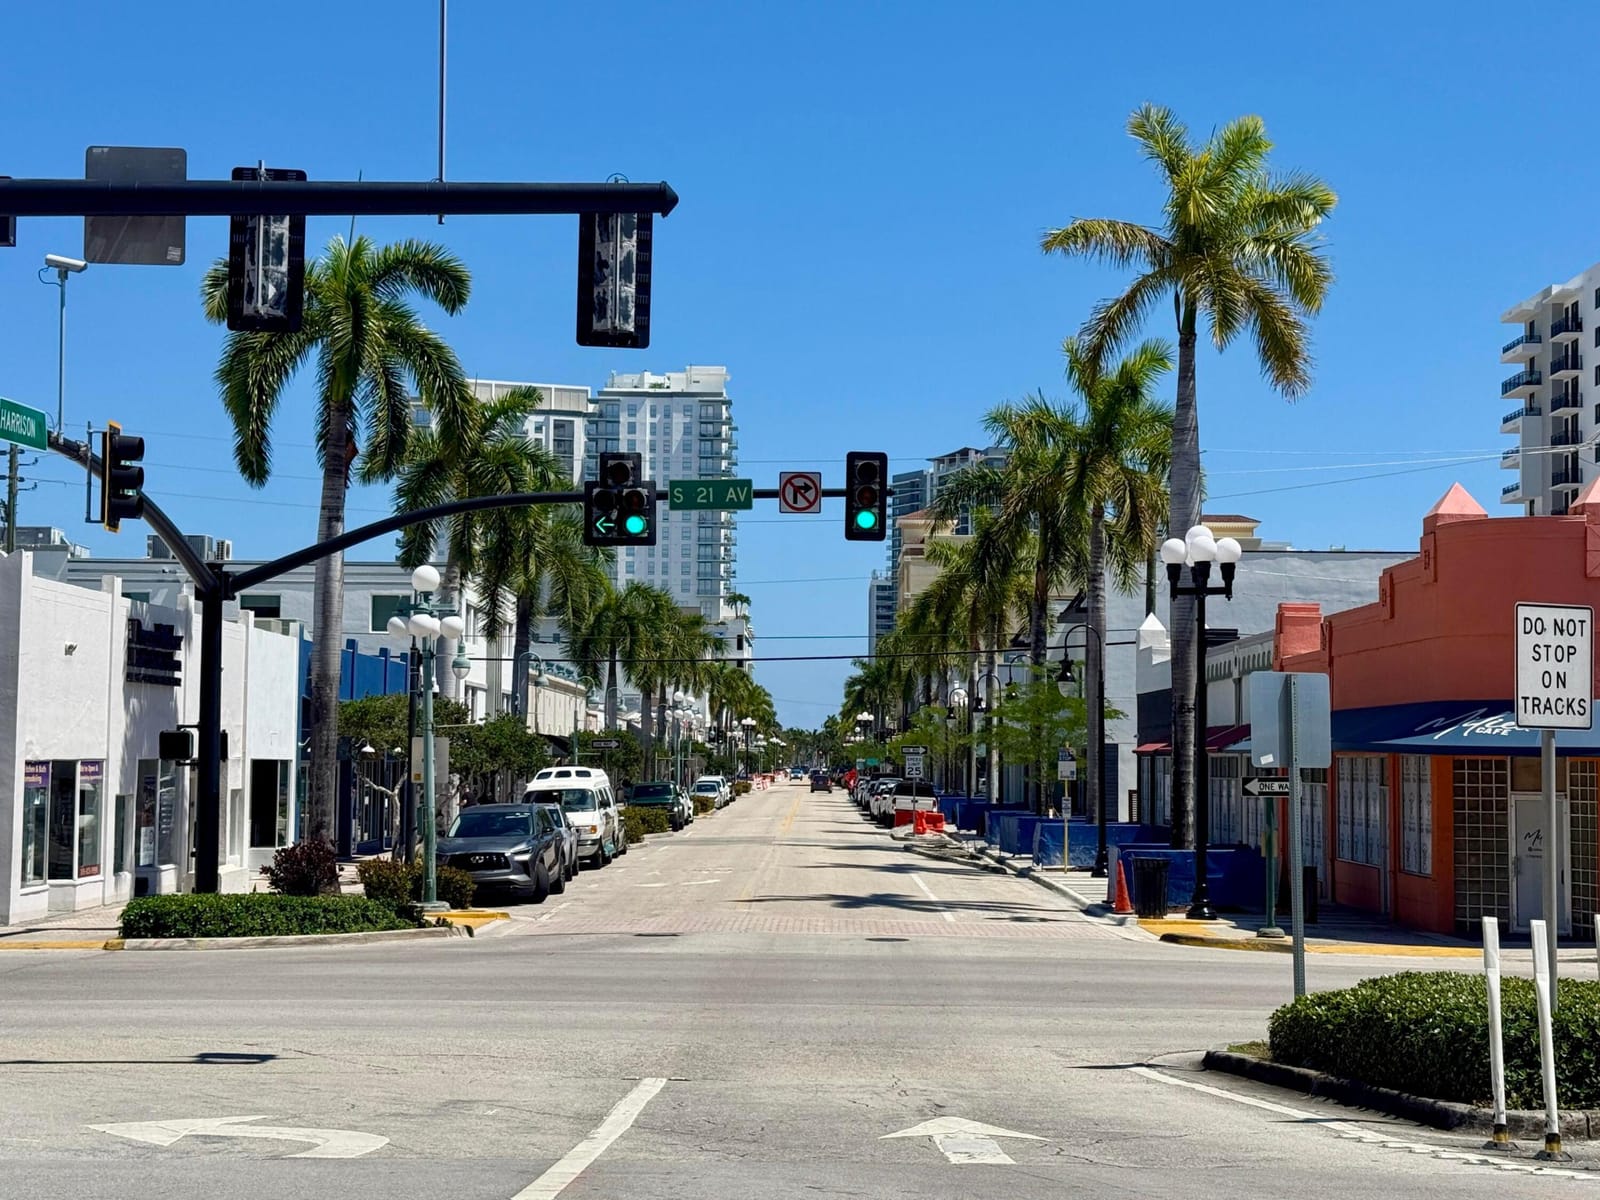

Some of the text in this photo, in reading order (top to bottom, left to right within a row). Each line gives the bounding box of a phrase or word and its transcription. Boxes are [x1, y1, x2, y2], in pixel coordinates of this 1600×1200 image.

[0, 408, 36, 438] HARRISON
[673, 486, 748, 503] S 21 AV
[1523, 616, 1587, 637] DO NOT
[1532, 643, 1577, 663] STOP
[1541, 670, 1567, 689] ON
[1521, 696, 1587, 716] TRACKS
[1475, 727, 1512, 736] CAFE
[907, 766, 922, 776] 25
[1259, 782, 1289, 791] ONE WA
